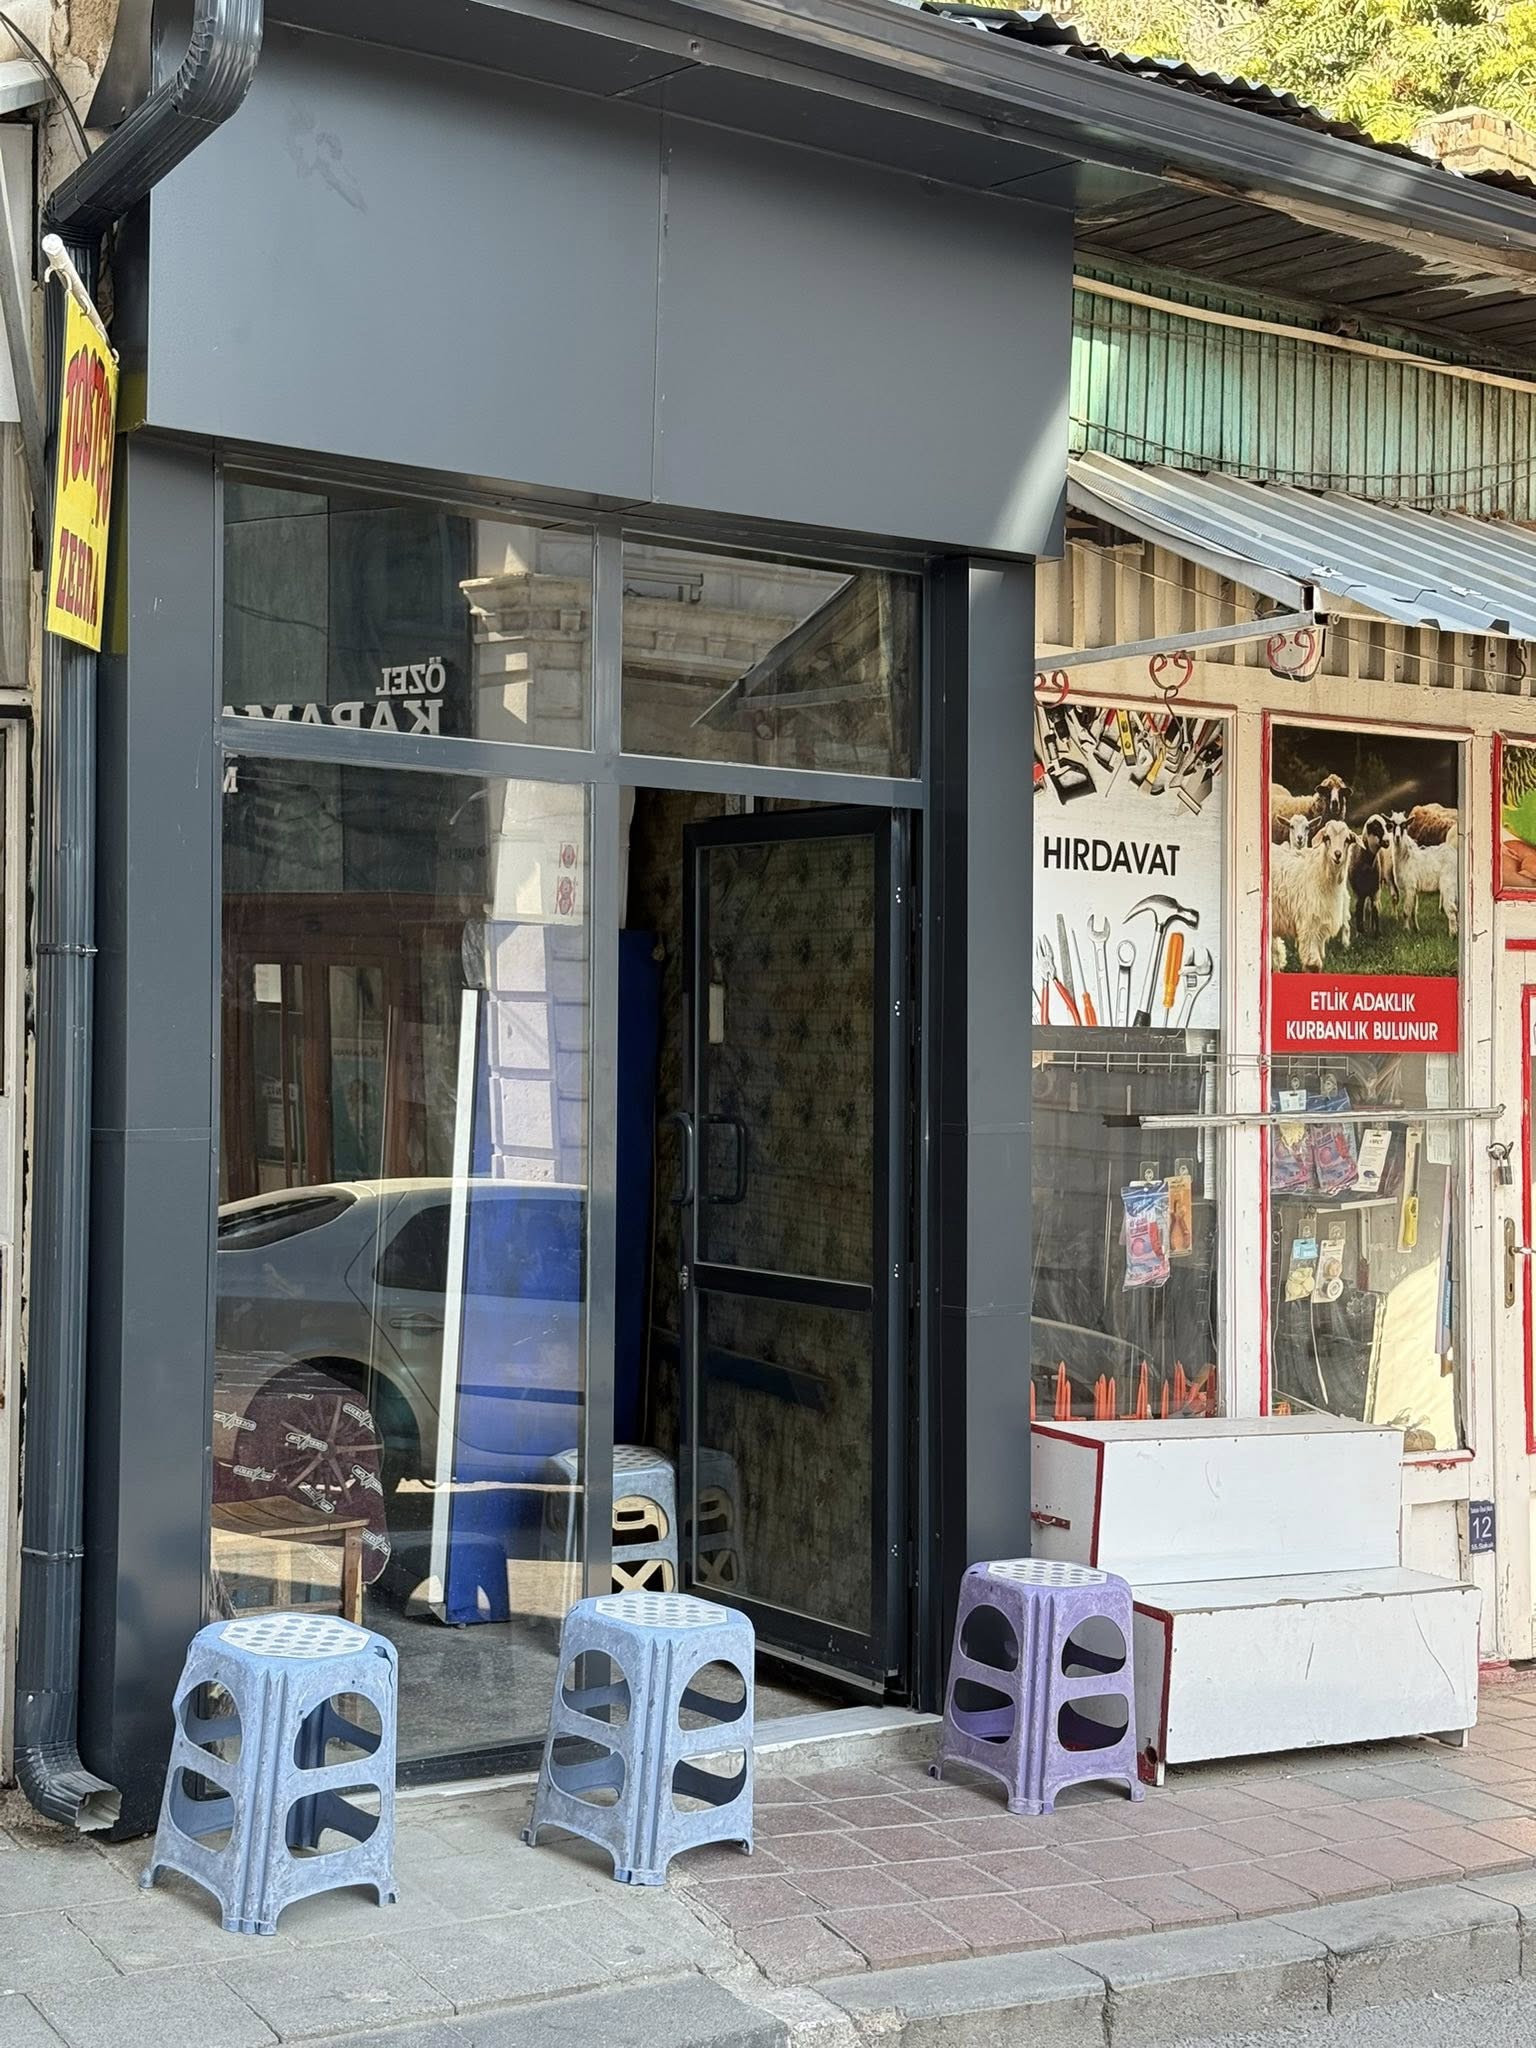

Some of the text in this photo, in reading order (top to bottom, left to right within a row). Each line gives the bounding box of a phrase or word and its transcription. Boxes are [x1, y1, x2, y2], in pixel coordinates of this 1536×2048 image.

[56, 527, 99, 627] ZEHRA
[1043, 836, 1180, 876] HIRDAVAT
[1311, 986, 1416, 1012] ETLİK ADAKLIK
[1286, 1020, 1439, 1041] KURBANLIK BULUNUR
[1473, 1516, 1492, 1539] 12
